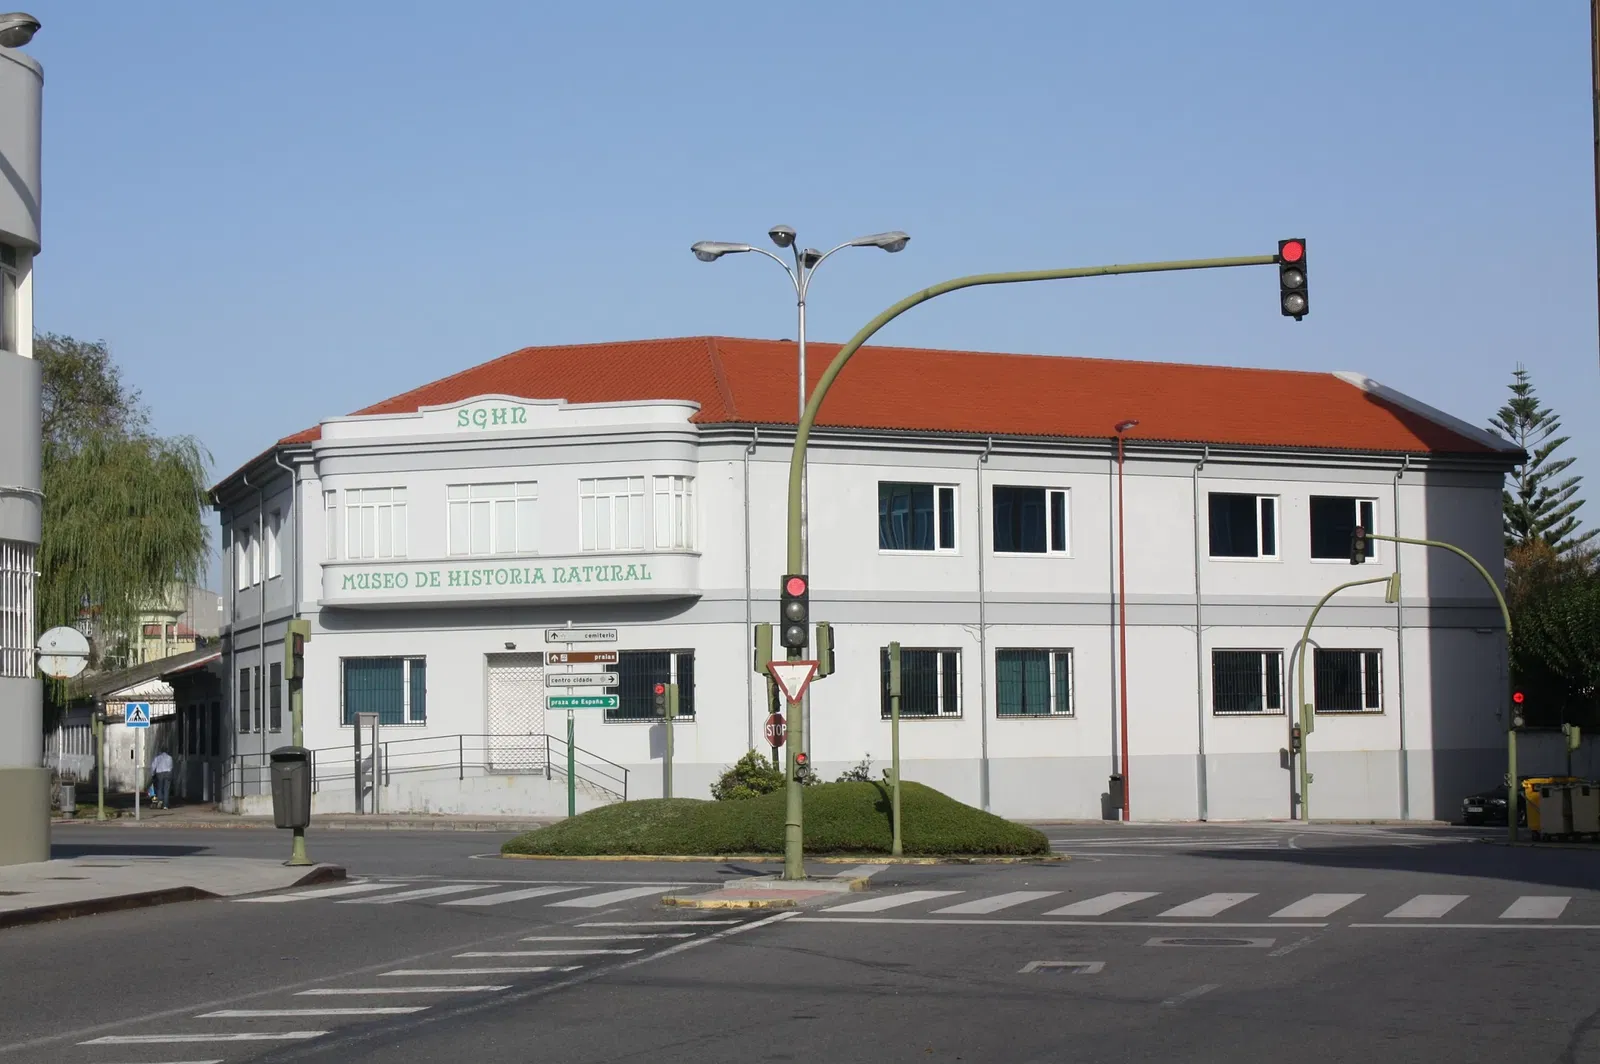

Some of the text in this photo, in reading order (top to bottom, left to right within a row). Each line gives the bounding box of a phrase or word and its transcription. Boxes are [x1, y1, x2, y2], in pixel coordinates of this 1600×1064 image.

[458, 407, 527, 429] SGHN
[342, 564, 652, 590] MUSEO DE HISTORIA NATURAL
[766, 724, 787, 736] STOP
